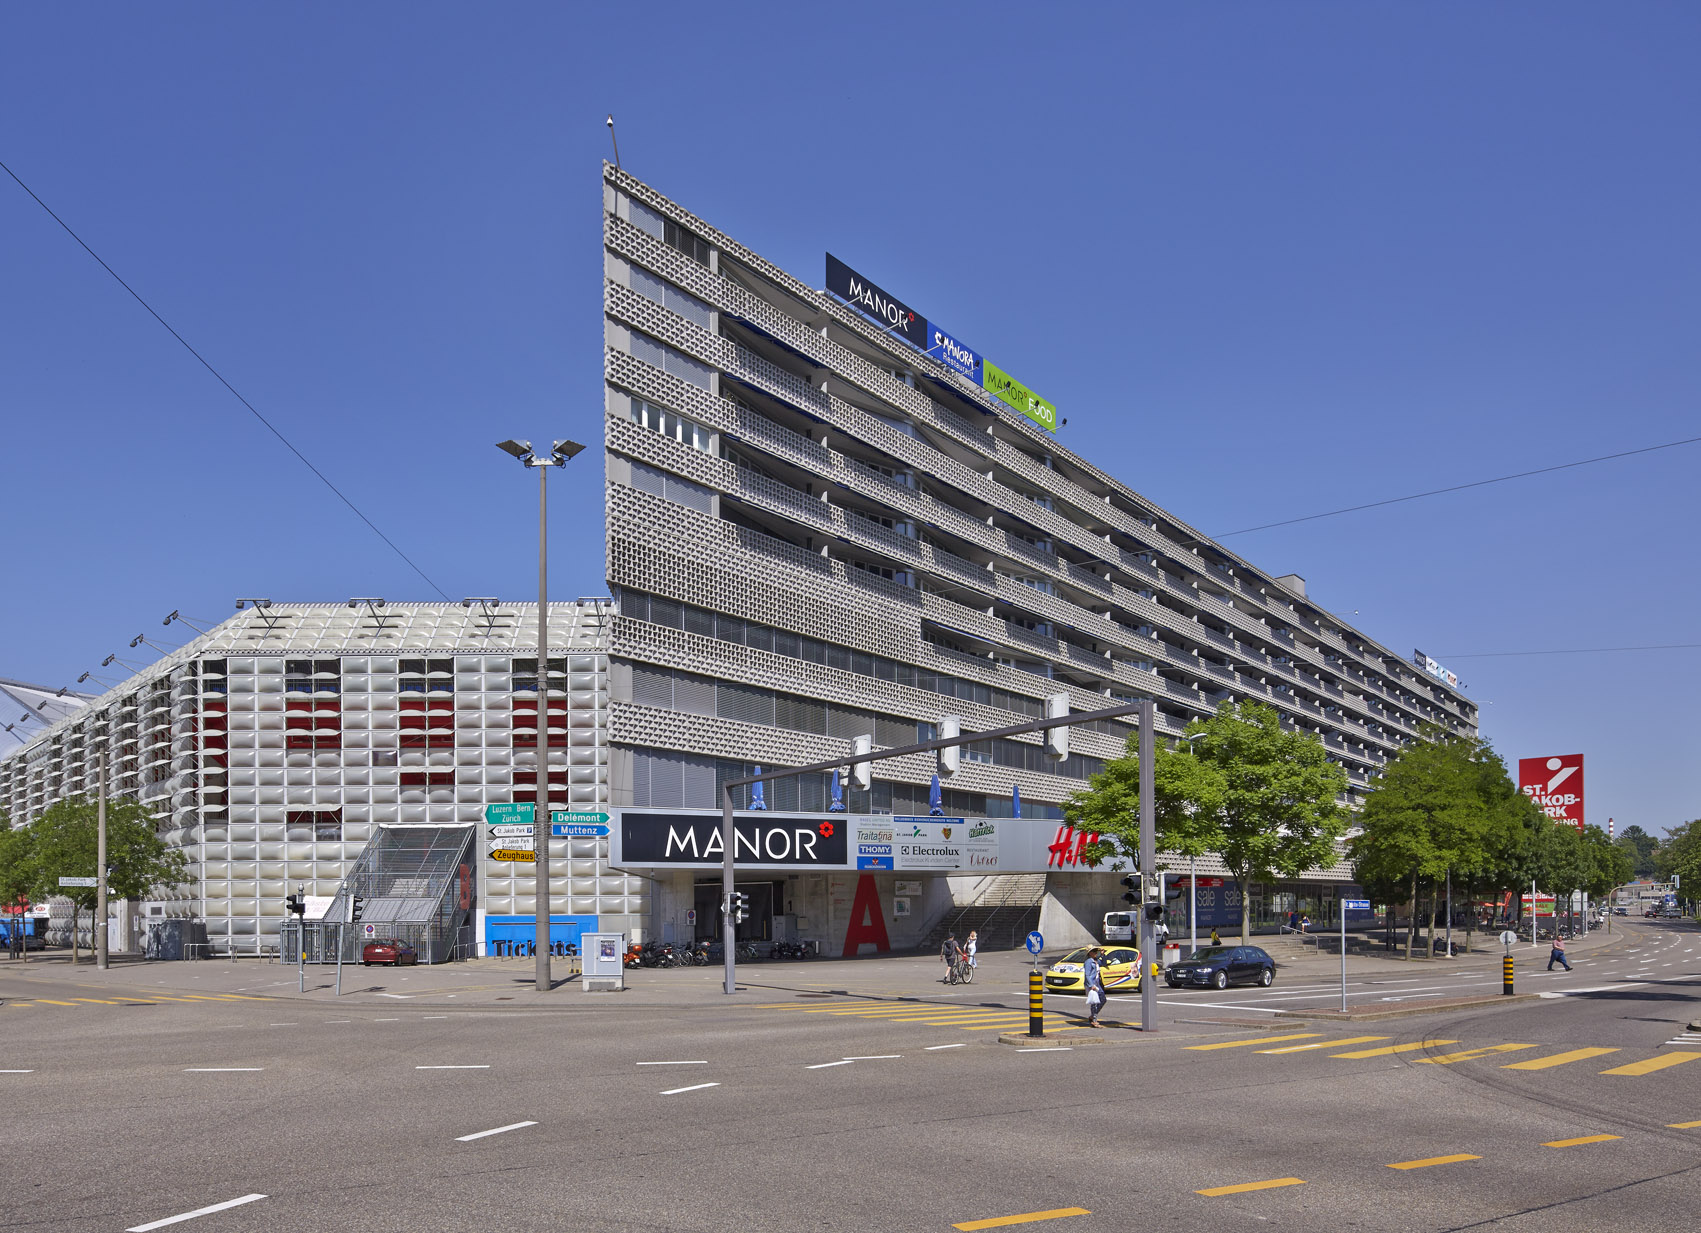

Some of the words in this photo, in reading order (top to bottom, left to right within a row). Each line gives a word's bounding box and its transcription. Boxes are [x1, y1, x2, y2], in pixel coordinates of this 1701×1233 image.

[849, 276, 909, 332] MANOR
[942, 336, 975, 371] MANORA
[987, 371, 1024, 406] MANOR
[1028, 397, 1053, 423] FOOD
[1522, 784, 1546, 796] ST.
[1530, 793, 1581, 807] AKOB-
[492, 805, 513, 813] Luzern
[501, 814, 522, 823] Zürich
[557, 813, 600, 822] Delémont
[560, 825, 598, 834] Muttenz
[857, 830, 893, 842] Traitafina
[665, 825, 818, 860] MANOR
[497, 851, 534, 861] Zeughaus
[912, 845, 960, 856] Electrolux
[842, 874, 891, 957] A
[492, 940, 578, 957] Tickts
